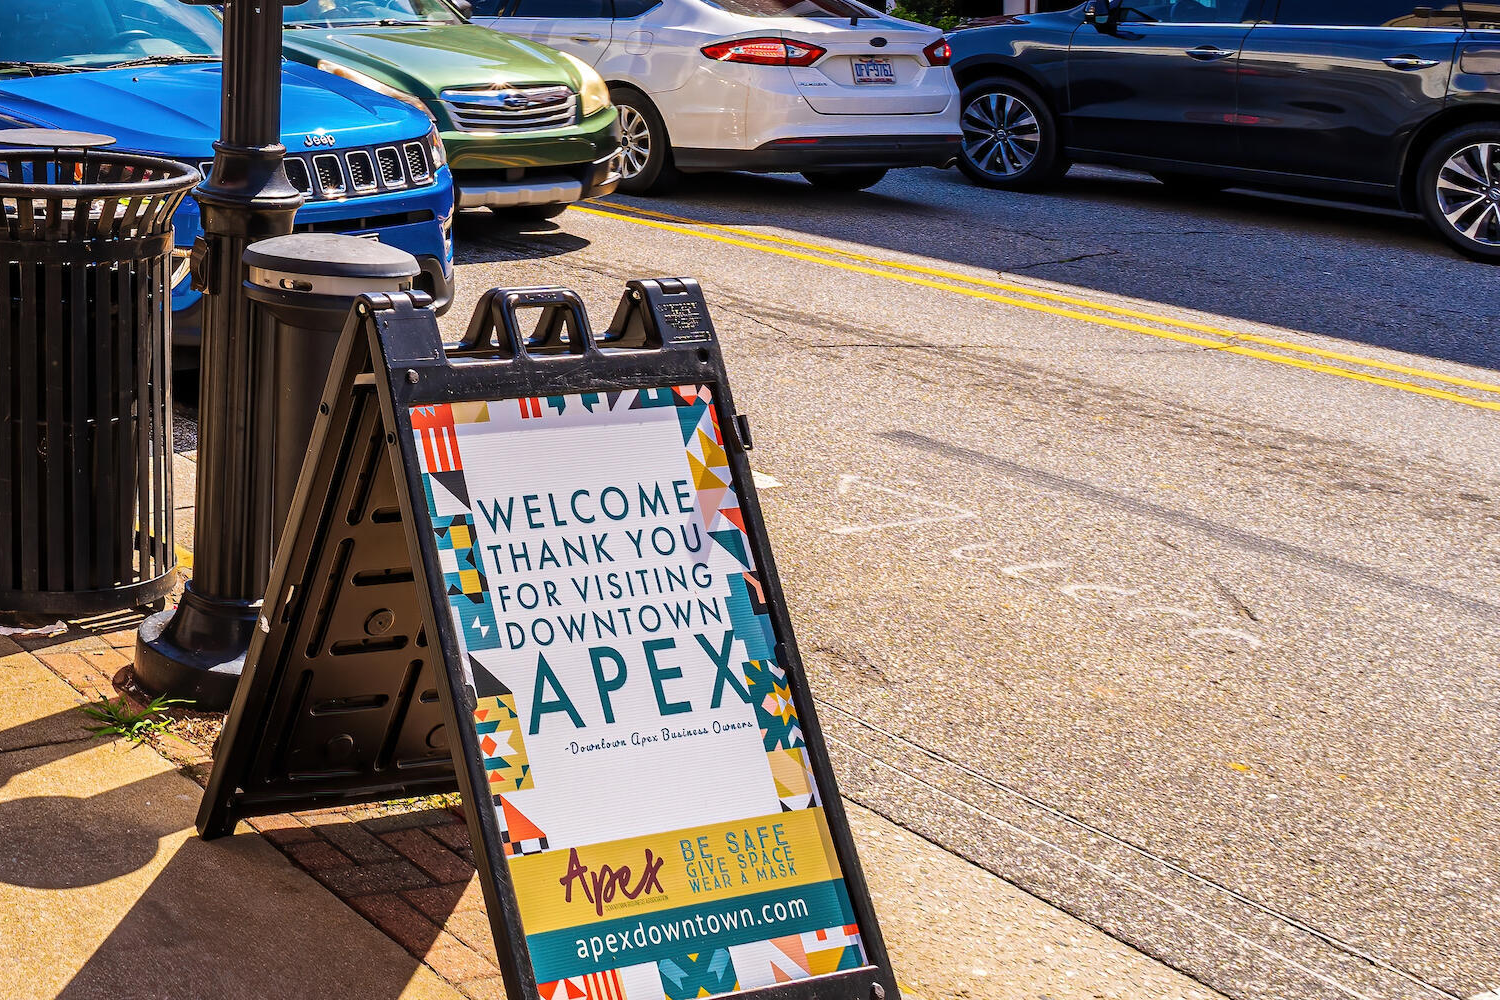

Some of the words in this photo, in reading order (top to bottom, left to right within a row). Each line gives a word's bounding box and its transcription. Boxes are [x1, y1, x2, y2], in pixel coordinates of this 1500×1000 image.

[304, 134, 336, 148] Jeep
[476, 479, 695, 535] WELCOME
[486, 533, 615, 575] THANK
[625, 523, 702, 558] YOU
[498, 580, 561, 612] FOR
[571, 562, 712, 604] VISITING
[505, 596, 723, 650] DOWNTOWN
[528, 629, 753, 736] APEX
[631, 731, 658, 747] Apex
[661, 727, 709, 742] Business
[712, 720, 753, 735] Owners
[679, 836, 713, 862] BE
[725, 823, 789, 854] SAFE
[685, 857, 725, 878] GIVE
[737, 846, 795, 869] SPACE
[559, 847, 665, 917] Apex
[689, 875, 732, 893] WEAR
[740, 871, 749, 884] A
[757, 862, 798, 882] MASK
[576, 898, 809, 963] apexdowntown.com
